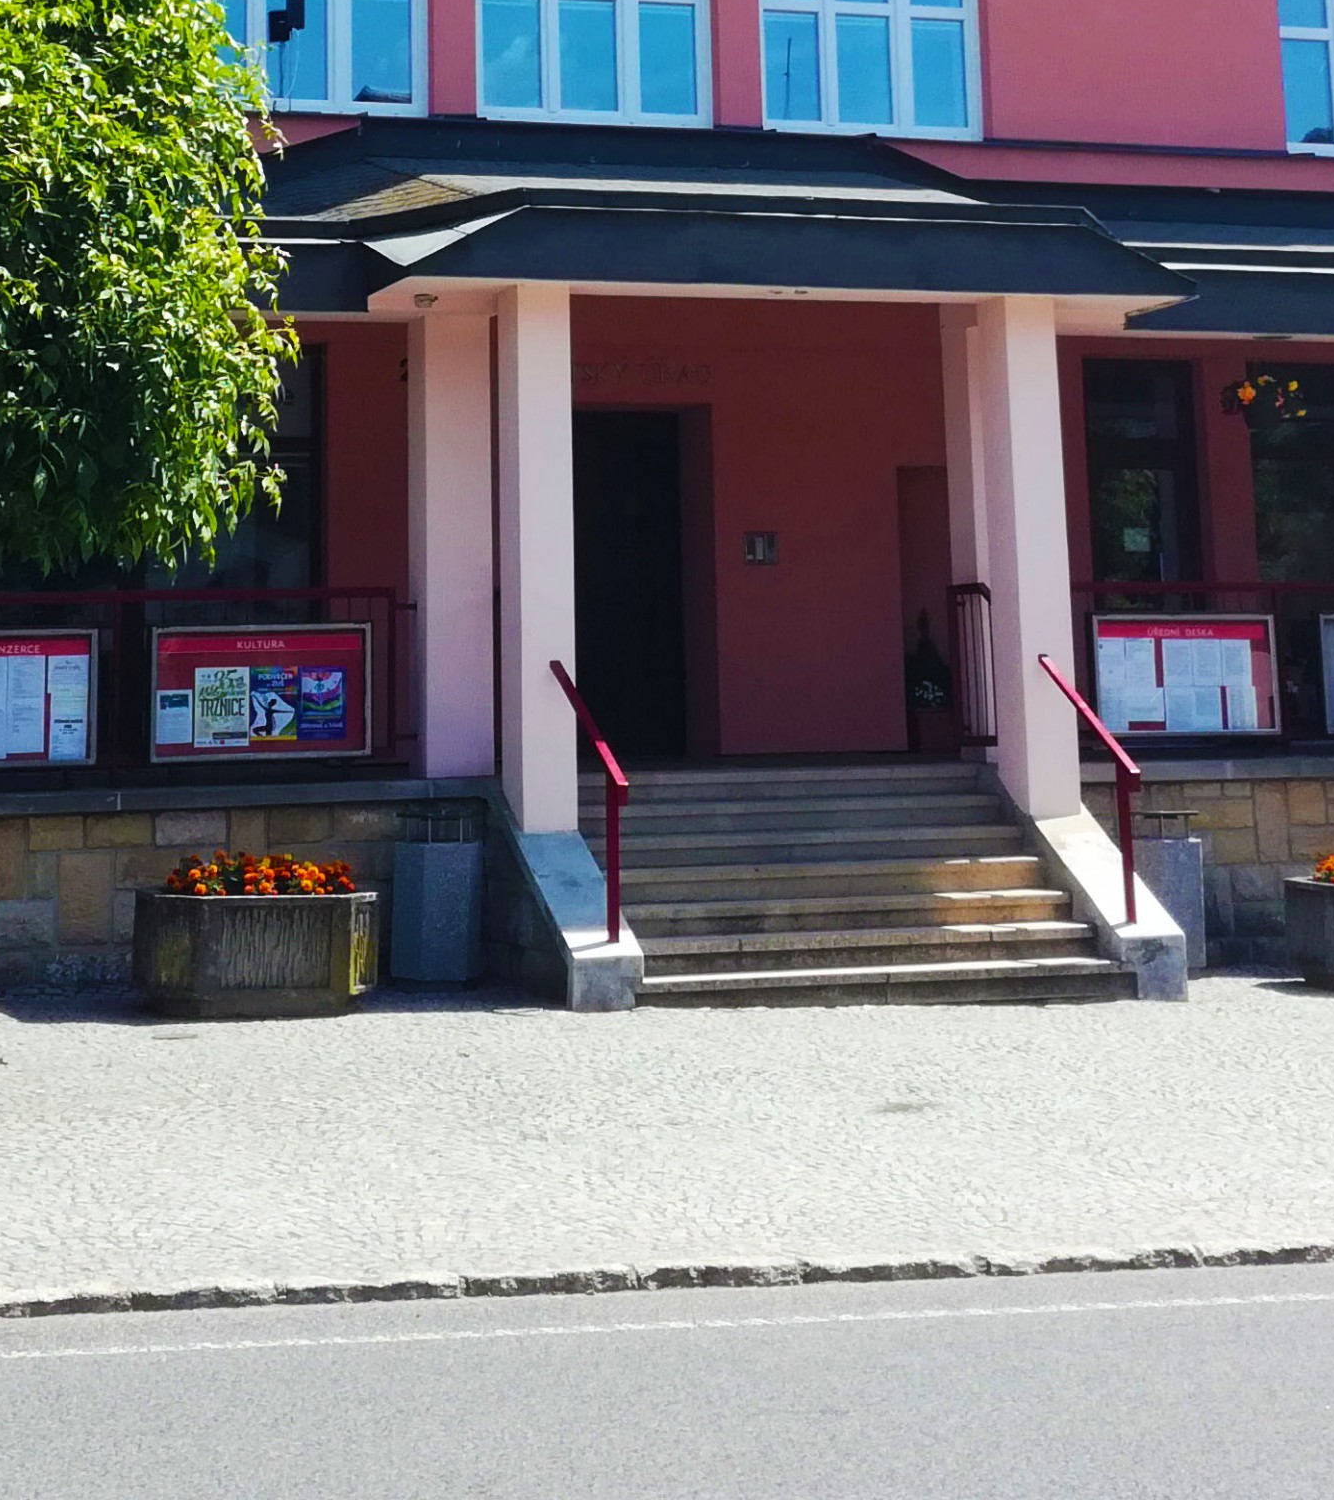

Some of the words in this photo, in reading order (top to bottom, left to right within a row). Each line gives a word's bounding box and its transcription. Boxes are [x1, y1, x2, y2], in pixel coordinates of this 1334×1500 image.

[1147, 626, 1181, 637] ÚŘEDNÍ
[1185, 627, 1214, 637] DESKA
[236, 639, 285, 649] KULTURA
